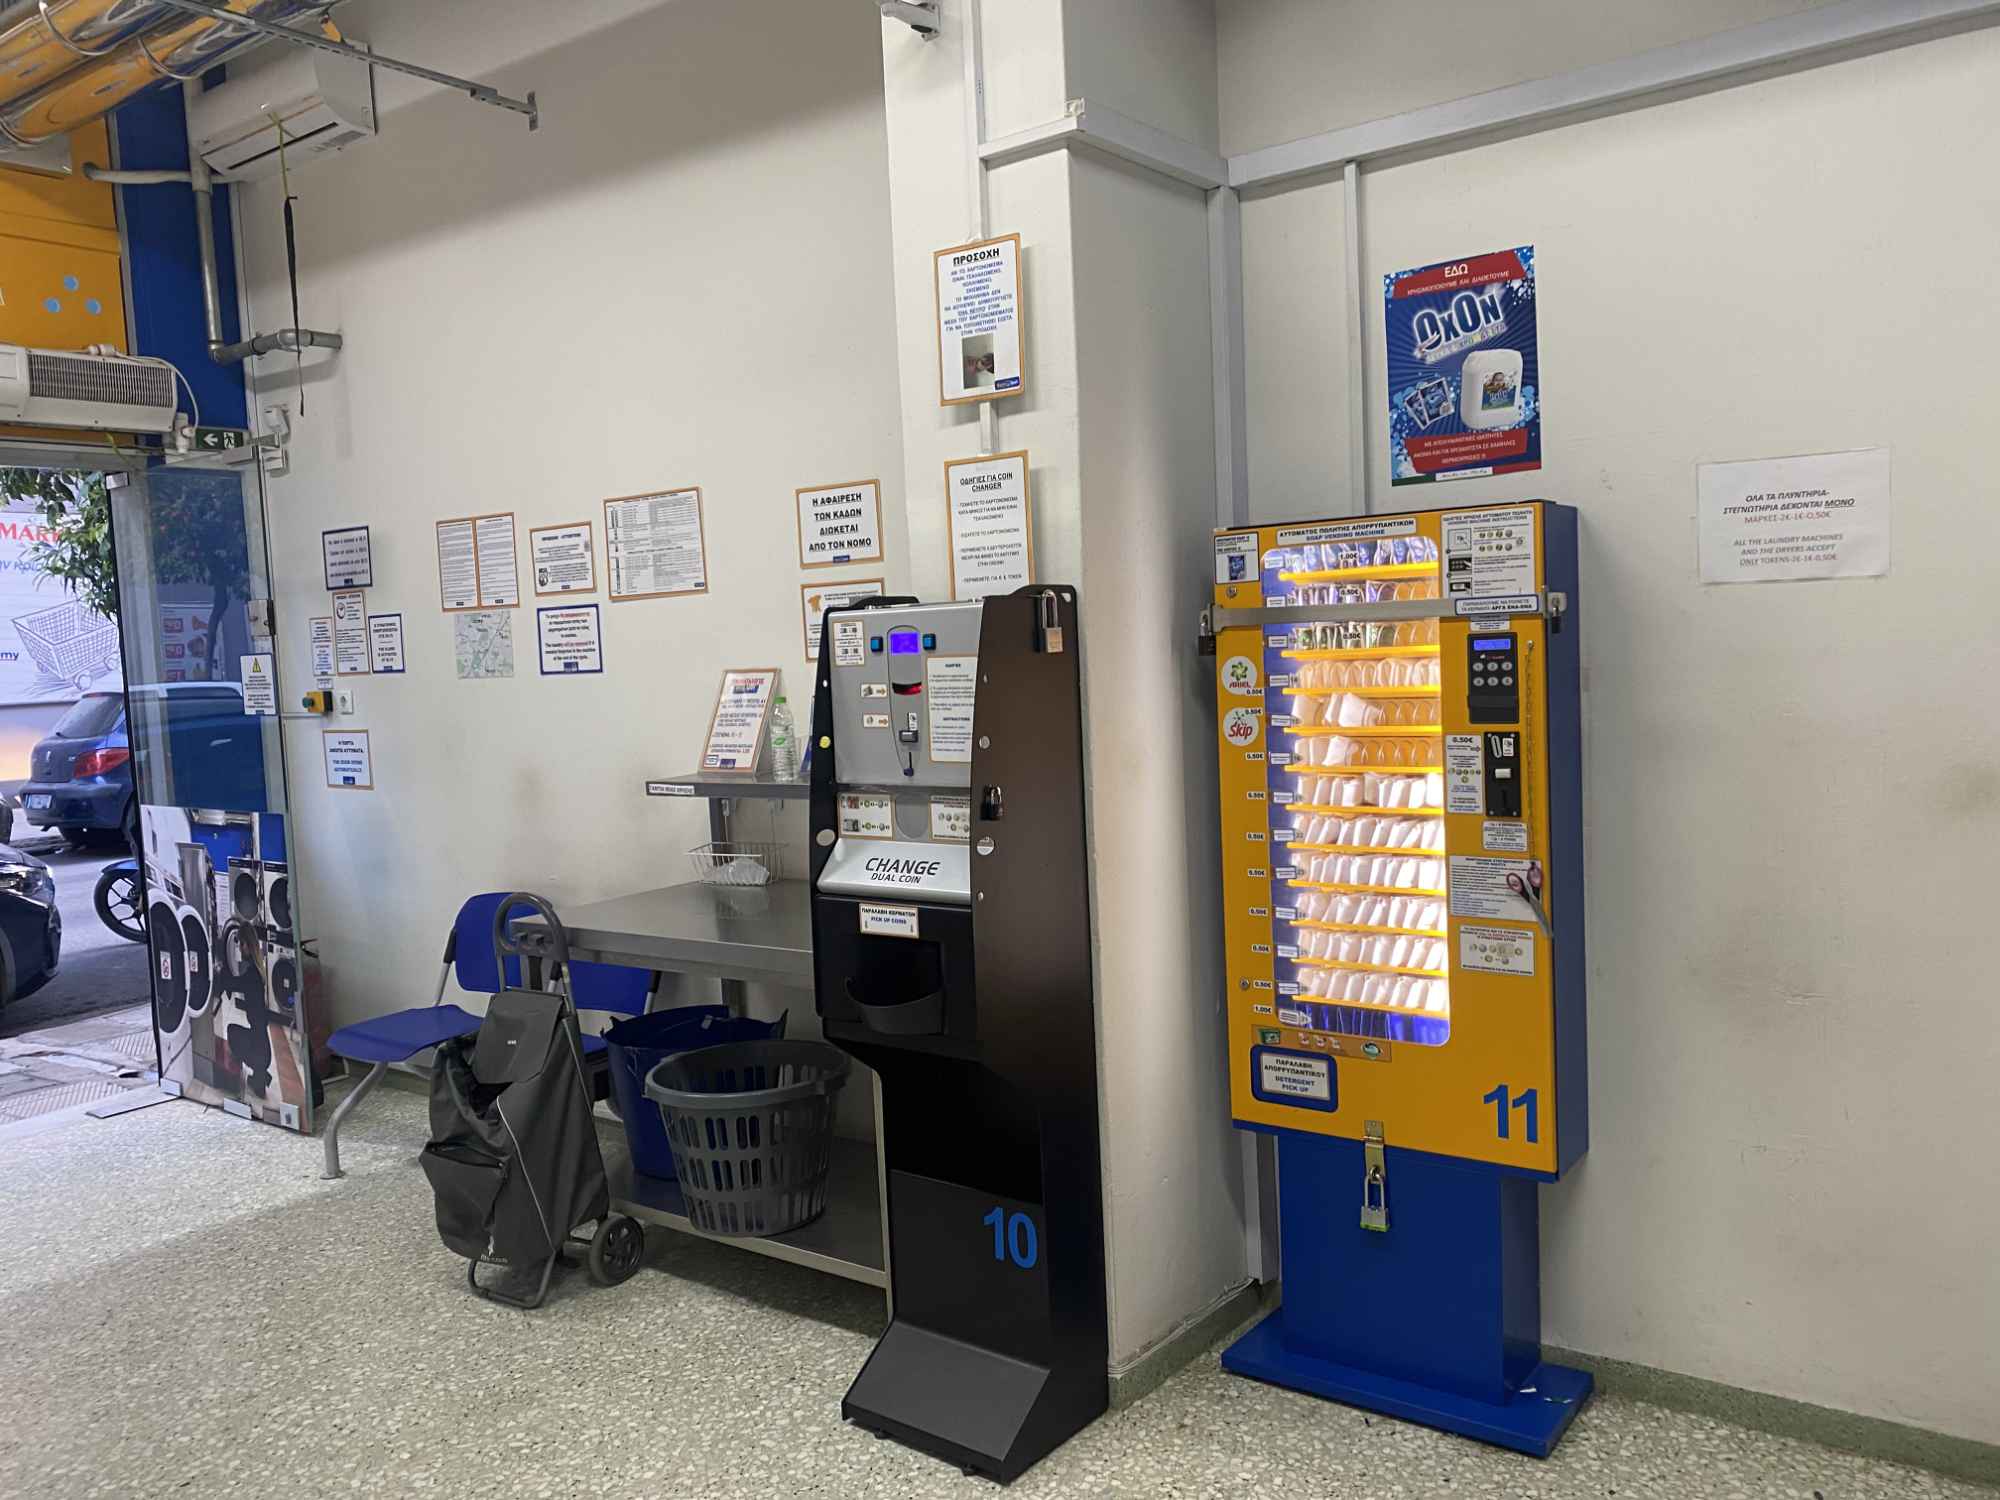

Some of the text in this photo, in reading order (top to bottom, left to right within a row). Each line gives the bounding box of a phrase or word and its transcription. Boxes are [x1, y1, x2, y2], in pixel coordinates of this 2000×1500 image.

[953, 248, 1000, 265] ΠΡΟΣΟΧΗ
[1444, 264, 1468, 278] ΕΔΩ
[960, 472, 1013, 486] ΟΔΗΓΙΕΣ ΓΙΑ COIN
[971, 482, 1002, 492] CHANGER
[812, 492, 862, 507] Η ΑΦΑΙΡΕΣΗ
[1723, 498, 1855, 514] ΣΤΕΓΝΩΤΗΡΙΑ ΔΕΧΟΝΤΑΙ ΜΟΝΟ
[814, 508, 862, 521] ΤΩΝ ΚΑΔΩΝ
[820, 524, 858, 536] ΔΙΩΚΕΤΑΙ
[1280, 520, 1414, 537] ΑΥΤΟΜΑΤΟΣ ΠΩΛΗΤΗΣ ΑΠΟΡΡΥΠΑΝΤΙΚΩΝ
[1325, 532, 1353, 540] VENDING
[1354, 529, 1385, 538] MACHINE
[809, 538, 872, 552] ΑΠΟ ΤΟΝ ΝΟΜΟ
[1764, 535, 1800, 545] LAUNDRY
[1801, 533, 1843, 542] MACHINES
[1806, 544, 1836, 552] ACCEPT
[1228, 721, 1253, 740] Skip
[865, 857, 941, 876] CHANGE
[871, 873, 922, 884] DUAL COIN
[861, 907, 888, 915] ΠΑΡΑΛΑΒΗ
[1276, 1058, 1312, 1068] ΠΑΡΑΛΑΒΗ
[1264, 1065, 1325, 1078] ΑΠΟΡΡΥΠΑΝΤΙΚΟΥ
[1276, 1076, 1315, 1086] DETERGENT
[1483, 1084, 1538, 1144] 11
[983, 1206, 1038, 1268] 10
